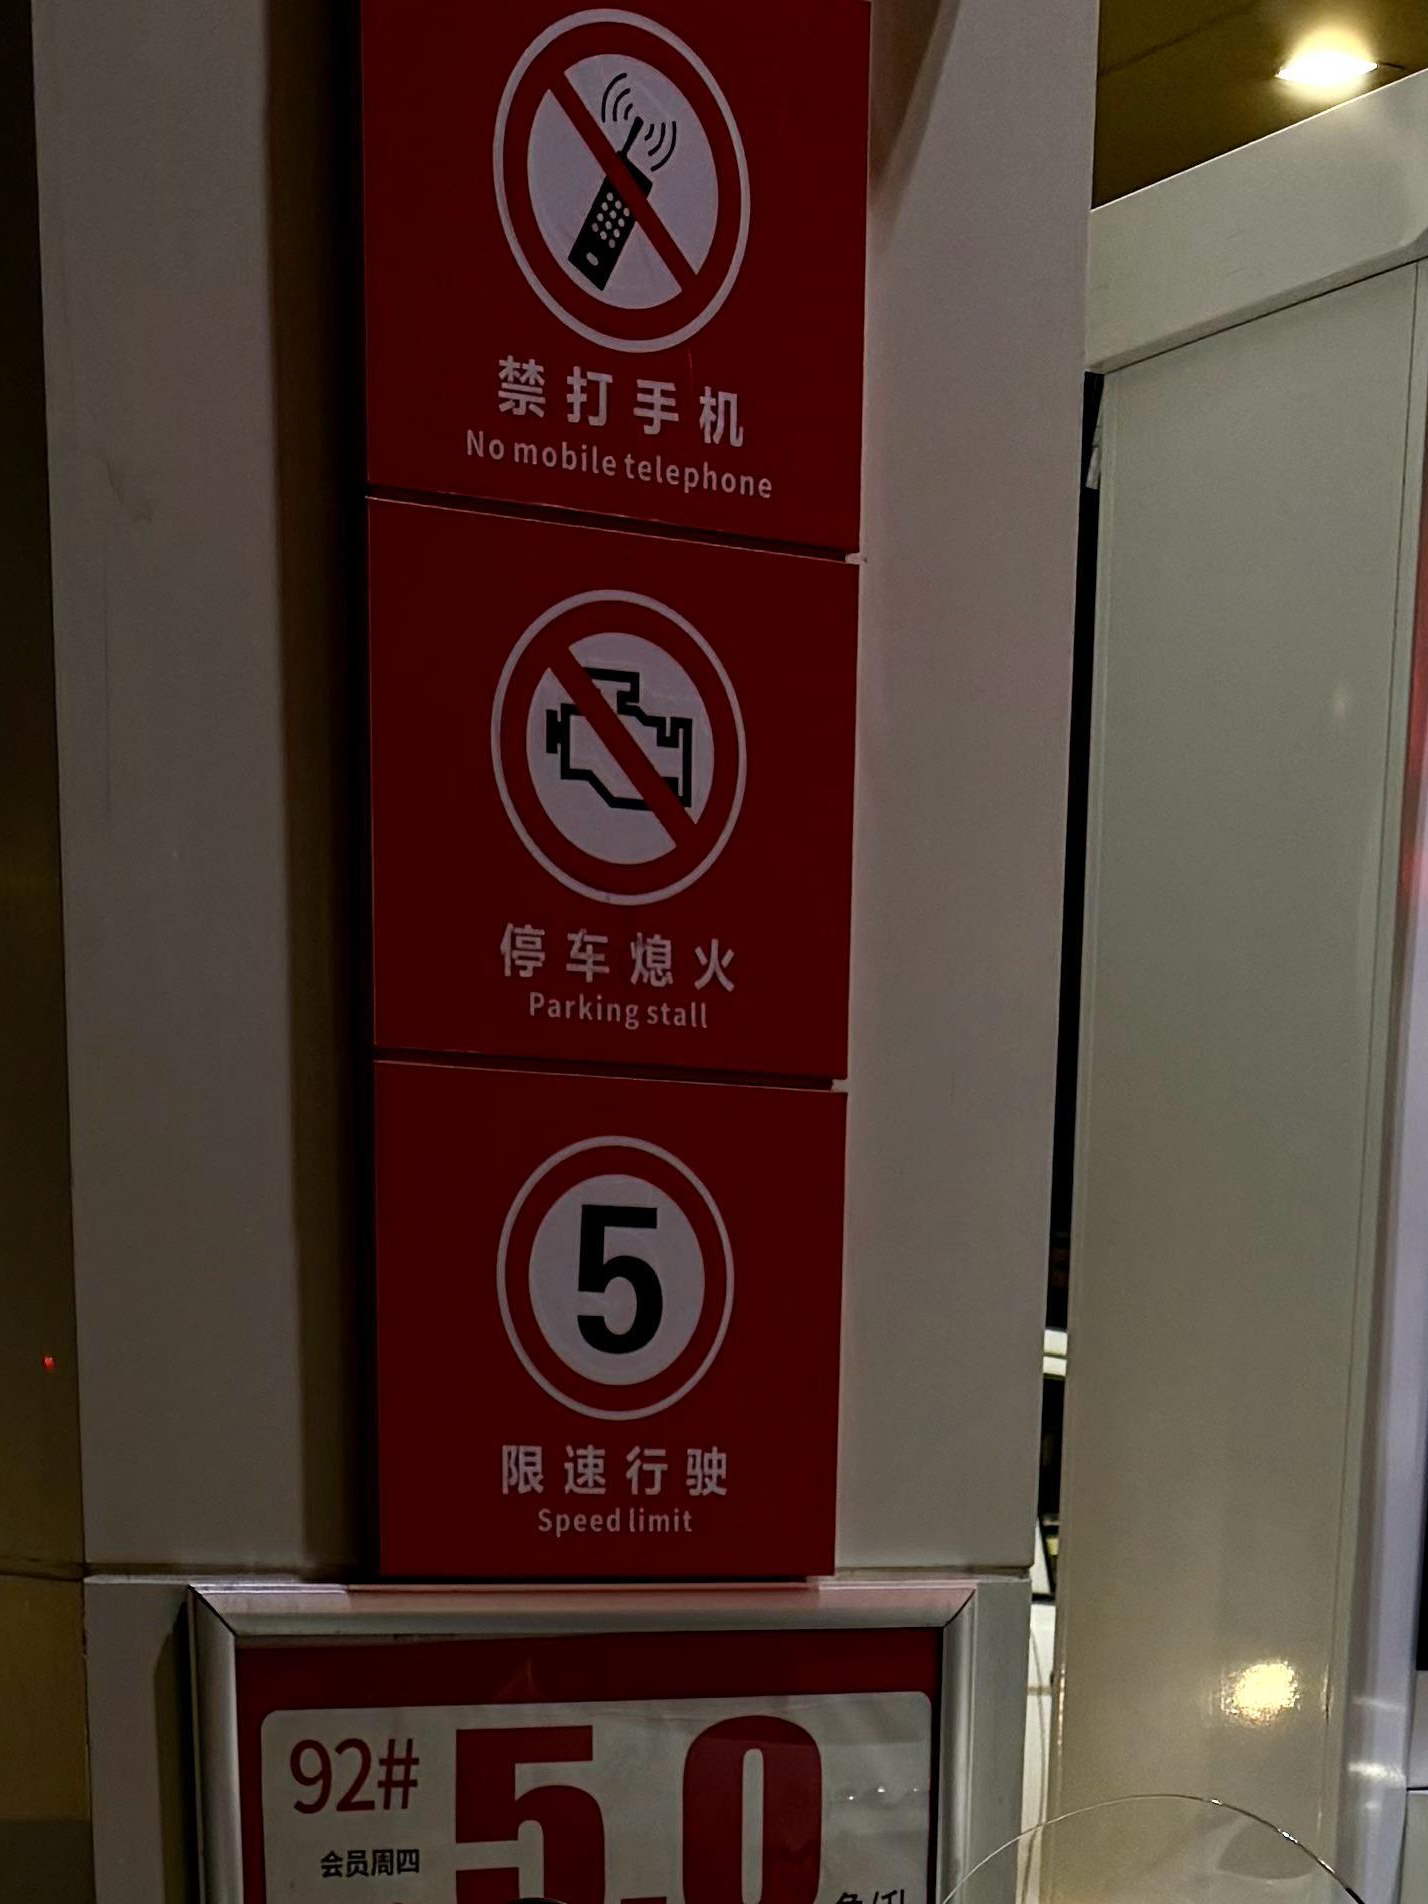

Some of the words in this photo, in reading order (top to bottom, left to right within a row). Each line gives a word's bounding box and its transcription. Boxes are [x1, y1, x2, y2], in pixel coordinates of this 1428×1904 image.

[498, 355, 744, 447] 禁打手机
[466, 429, 505, 463] No
[513, 438, 617, 477] mobile
[624, 452, 774, 500] telephone
[500, 923, 735, 992] 停车熄火
[529, 992, 640, 1030] Parking
[647, 999, 708, 1029] stall
[576, 1203, 663, 1354] 5
[501, 1444, 728, 1497] 限速行驶
[538, 1507, 620, 1537] Speed
[628, 1507, 693, 1533] limit
[289, 1737, 421, 1815] 92#
[320, 1848, 421, 1879] 会员周四
